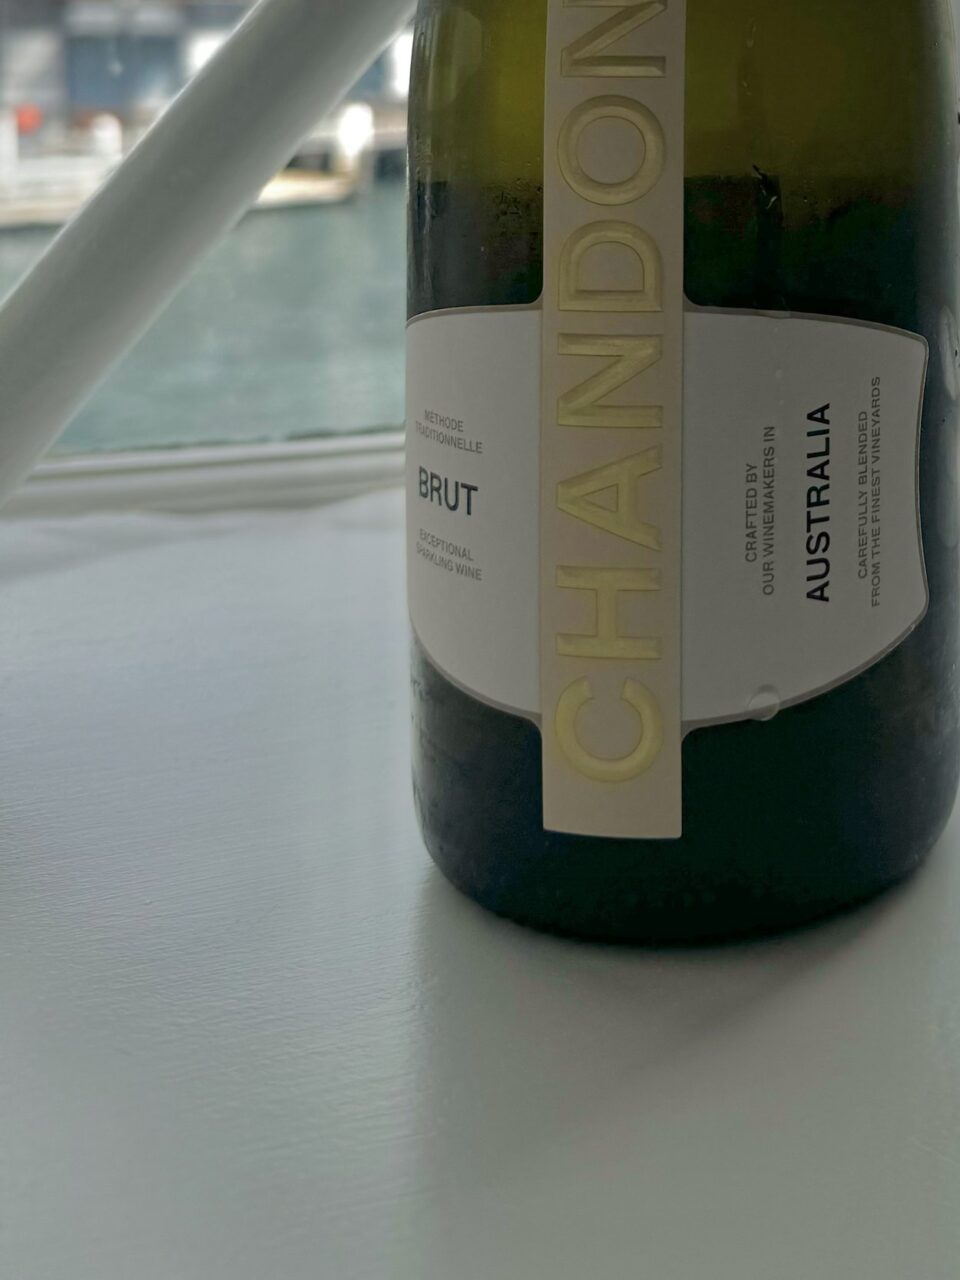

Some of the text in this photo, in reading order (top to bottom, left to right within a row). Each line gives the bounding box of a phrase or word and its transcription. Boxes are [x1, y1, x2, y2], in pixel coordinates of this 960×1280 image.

[419, 465, 479, 516] BRUT
[455, 561, 482, 581] WINE
[745, 463, 757, 563] CRAFTED BY
[762, 426, 775, 596] OUR WINEMAKERS IN
[805, 402, 831, 603] AUSTRALIA
[858, 411, 868, 579] CAREFULLY BLENDED
[871, 376, 881, 607] FROM THE FINEST VINEYARDS
